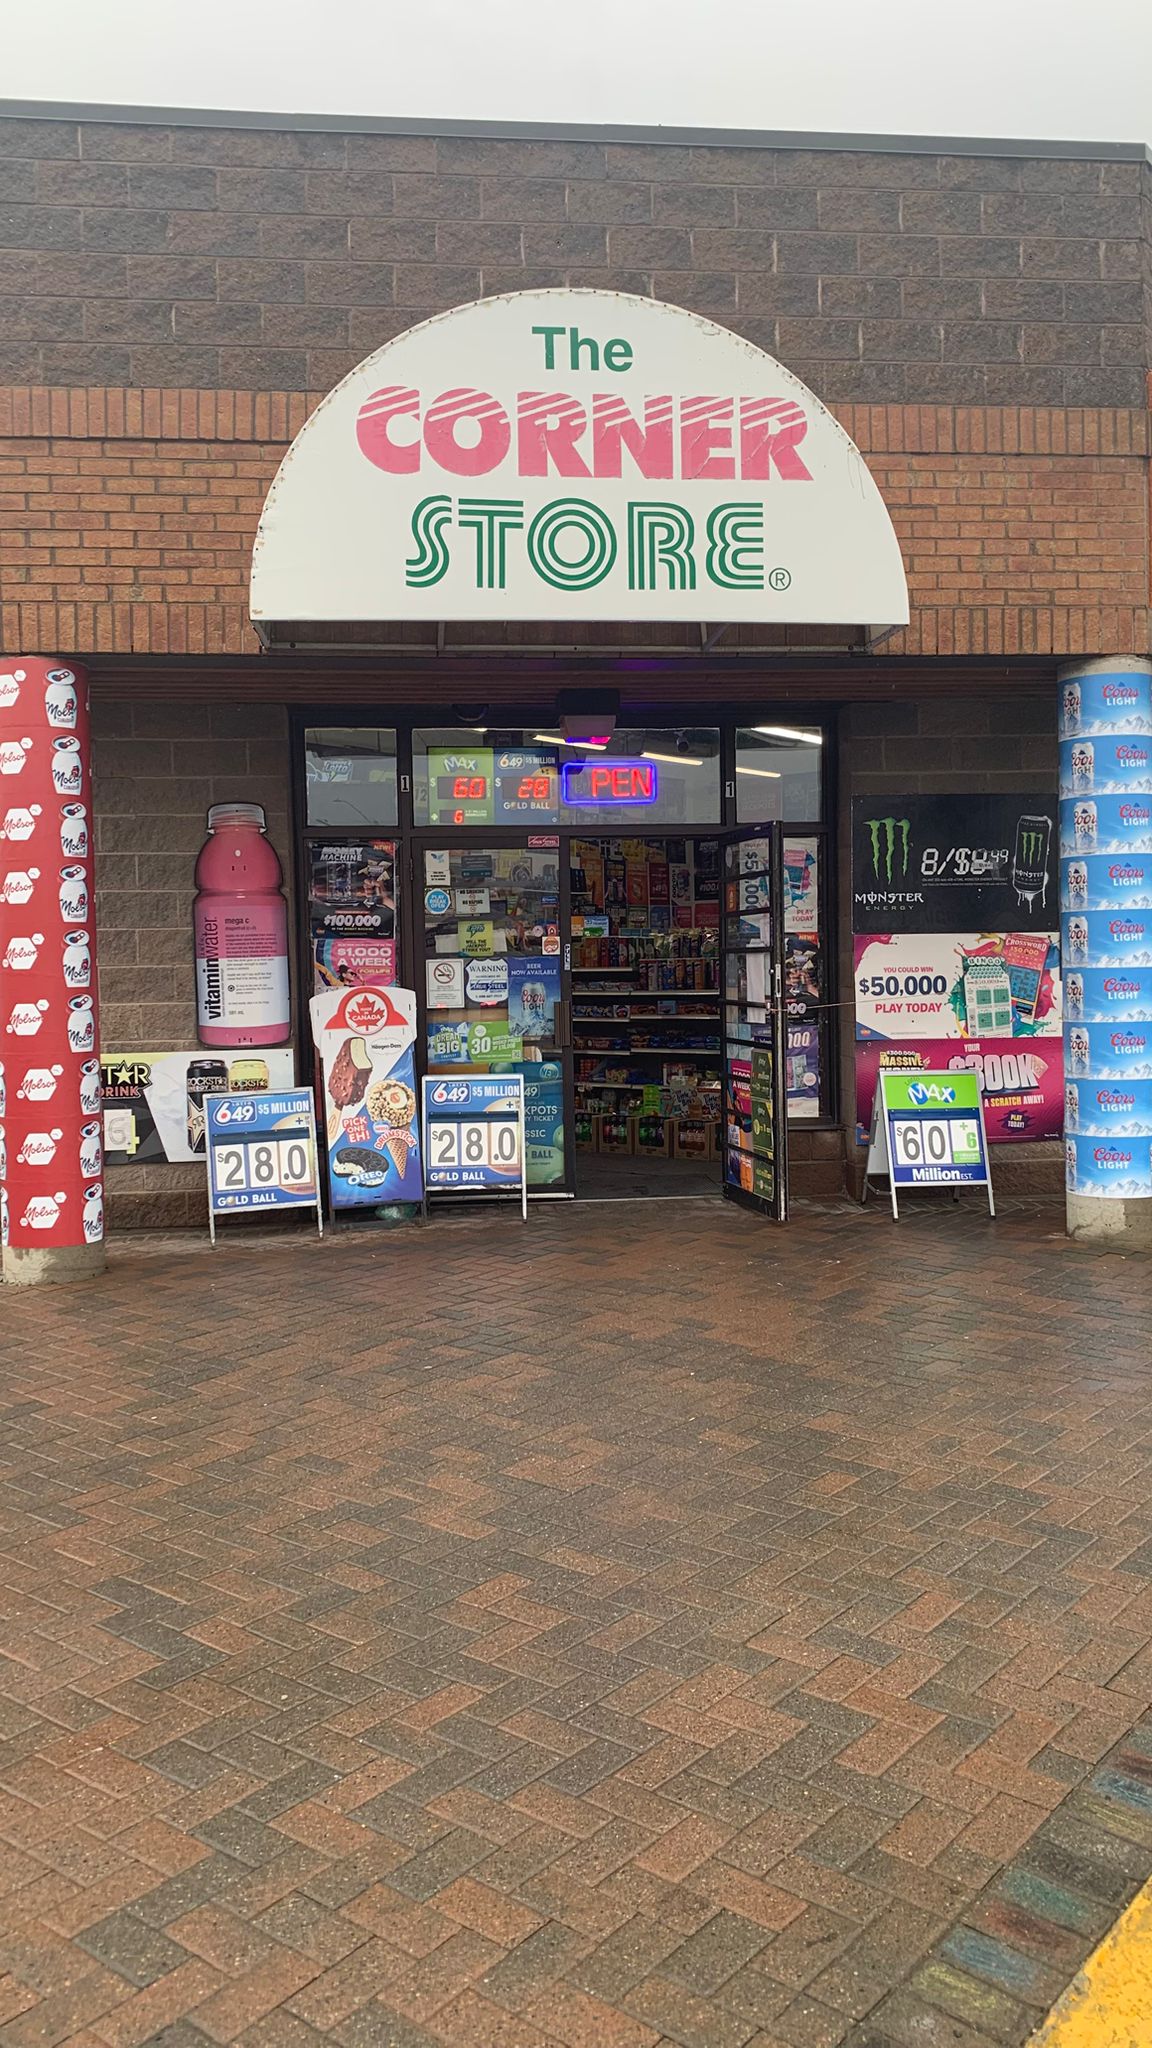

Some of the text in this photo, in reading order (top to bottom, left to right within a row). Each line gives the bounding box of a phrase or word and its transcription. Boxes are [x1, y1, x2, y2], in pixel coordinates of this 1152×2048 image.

[532, 325, 634, 373] The
[355, 384, 815, 482] CORNER
[404, 494, 765, 592] STORE
[0, 686, 20, 697] olson
[1103, 683, 1139, 698] Coors
[1106, 697, 1137, 706] LIGHT
[1116, 745, 1149, 760] Coors
[444, 756, 477, 772] MAX
[1120, 759, 1147, 767] LIGHT
[402, 776, 409, 791] 1
[453, 777, 486, 799] 60
[518, 778, 550, 799] 28
[726, 782, 733, 797] 1
[530, 802, 550, 810] BALL
[1119, 803, 1150, 818] Coors
[3, 818, 36, 833] Molson
[1123, 818, 1149, 826] LIGHT
[321, 847, 363, 855] MONEY
[1108, 863, 1145, 879] Coors
[3, 881, 35, 896] Molson
[1113, 878, 1143, 886] LIGHT
[855, 891, 925, 904] MONSTER
[324, 915, 382, 928] $100,000
[1109, 919, 1145, 934] Coors
[1113, 933, 1143, 942] LIGHT
[1005, 937, 1048, 952] CROSSWORD
[6, 946, 38, 962] Molson
[337, 947, 392, 958] $1,000
[337, 958, 392, 966] A WEEK
[968, 956, 1001, 965] BINGO
[859, 975, 947, 996] $50,000
[1103, 977, 1141, 992] Coors
[1107, 991, 1139, 1000] LIGHT
[788, 1003, 807, 1014] 00
[875, 1002, 943, 1013] PLAY TODAY
[10, 1012, 44, 1028] Molson
[352, 1014, 382, 1022] CANADA
[471, 1036, 492, 1055] 30
[1110, 1032, 1146, 1047] Coors
[437, 1041, 460, 1054] BIG
[964, 1043, 981, 1052] YOUR
[1114, 1045, 1144, 1054] LIGHT
[880, 1056, 923, 1066] MASSIVE
[101, 1065, 149, 1085] TAR
[21, 1077, 57, 1093] Molson
[472, 1086, 483, 1097] $5
[484, 1085, 520, 1097] MILLION
[908, 1082, 953, 1105] MAX
[1096, 1090, 1135, 1104] Coors
[258, 1104, 270, 1115] $5
[271, 1100, 310, 1115] MILLION
[984, 1094, 1045, 1108] A SCRATCH AWAY!
[1101, 1103, 1133, 1112] LIGHT
[524, 1106, 558, 1115] KPOTS
[343, 1118, 367, 1129] PICK
[347, 1125, 365, 1134] ONE
[1008, 1121, 1026, 1129] TODAY!
[349, 1131, 371, 1143] EH!
[375, 1129, 417, 1149] DRUMSTICK
[525, 1129, 546, 1138] SSIC
[21, 1141, 57, 1157] Molson
[531, 1151, 553, 1159] BALL
[1094, 1146, 1132, 1162] Coors
[1097, 1160, 1130, 1169] LIGHT
[347, 1170, 383, 1185] OREO
[430, 1171, 485, 1181] GOLD BALL
[912, 1168, 960, 1181] Million
[218, 1193, 277, 1206] GOLD BALL
[24, 1205, 60, 1221] Molson
